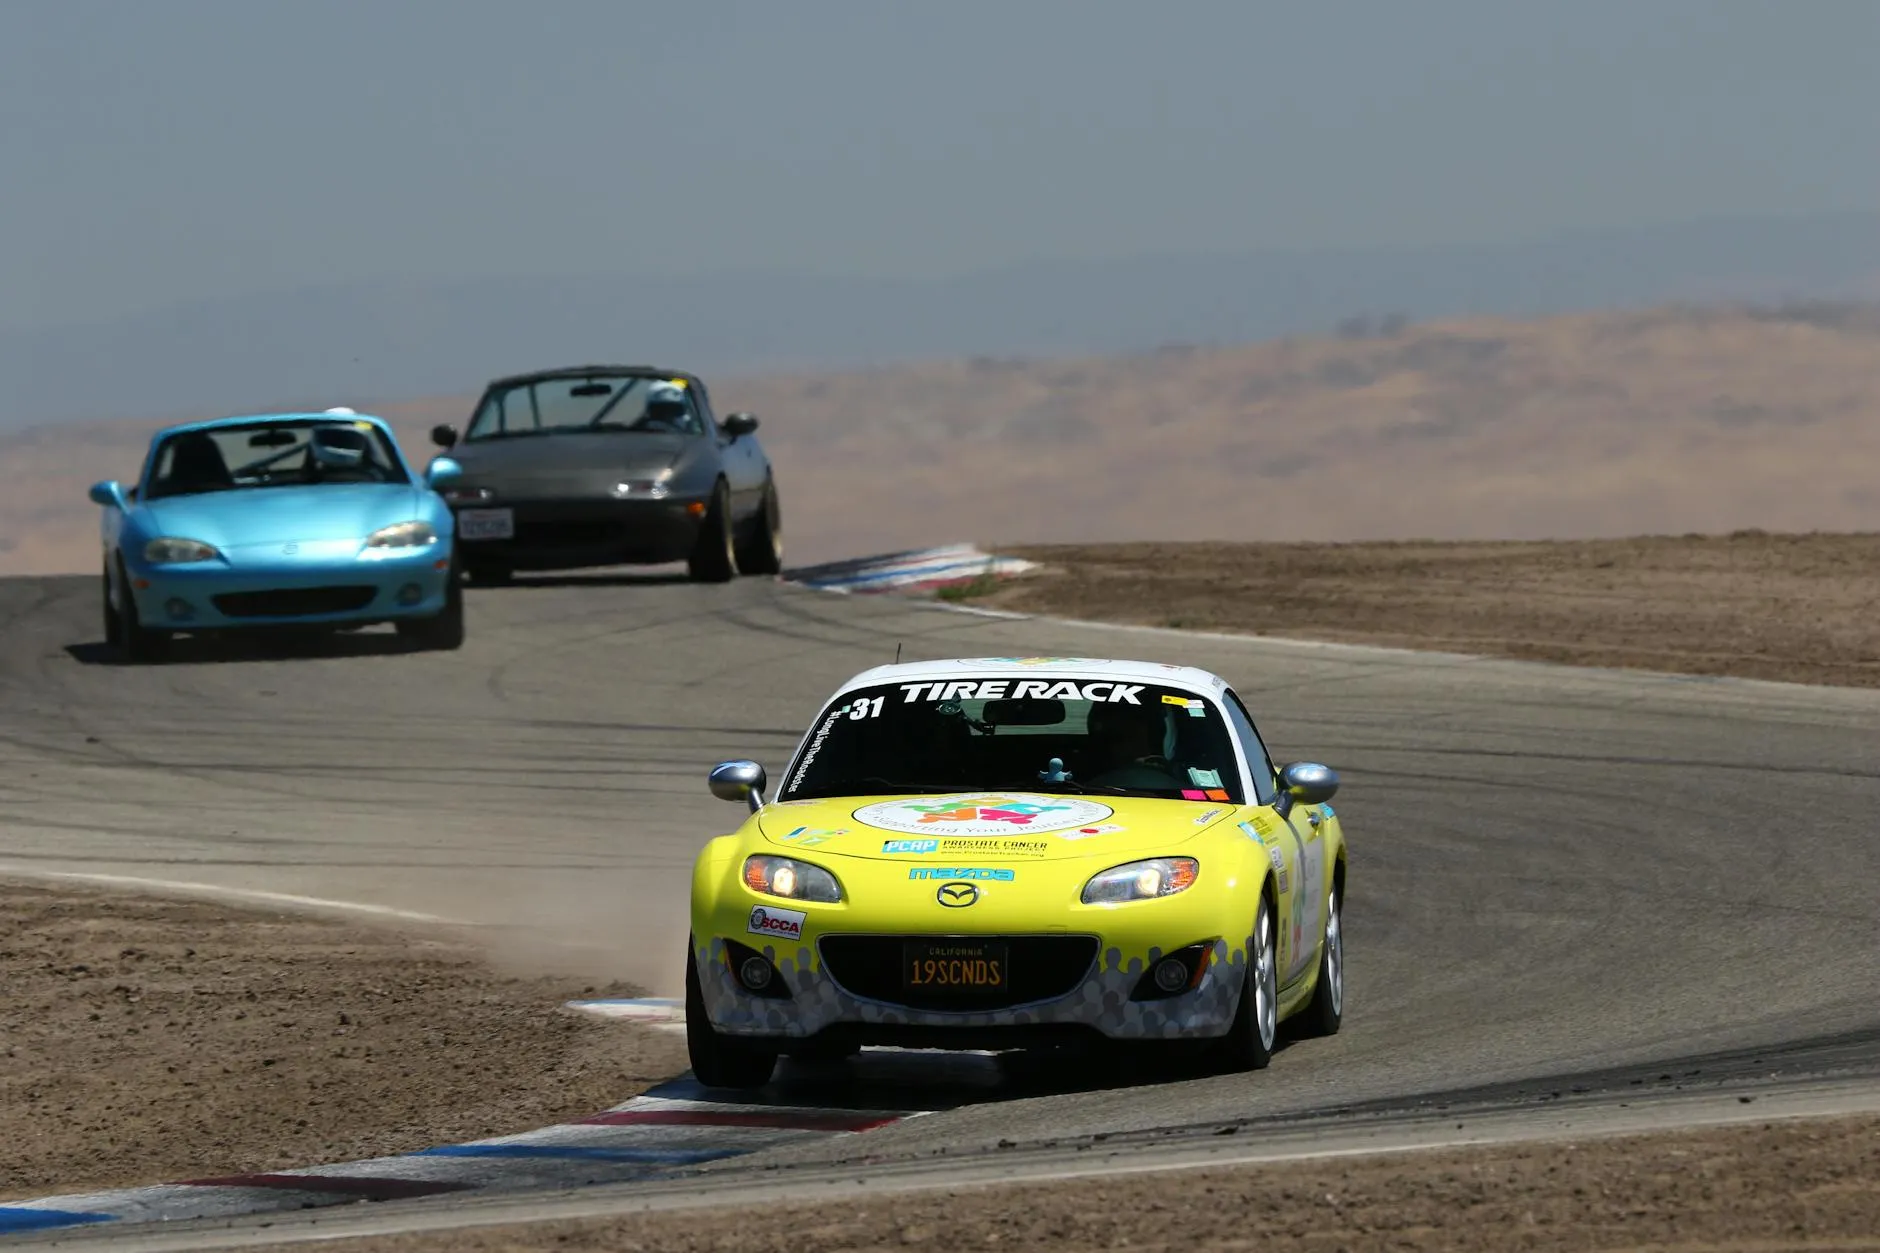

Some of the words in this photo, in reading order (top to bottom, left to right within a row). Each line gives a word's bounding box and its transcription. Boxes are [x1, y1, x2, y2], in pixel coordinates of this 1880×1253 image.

[900, 681, 1009, 703] TIRE
[1011, 681, 1146, 705] RACK
[849, 696, 885, 720] 31
[788, 710, 842, 793] #LongLiveTheRoadster
[887, 840, 936, 851] PCAP
[1003, 841, 1048, 849] CANCER
[762, 917, 799, 932] SCCA
[929, 947, 983, 956] CALIFORNIA
[911, 960, 1003, 985] 19SCNDS
